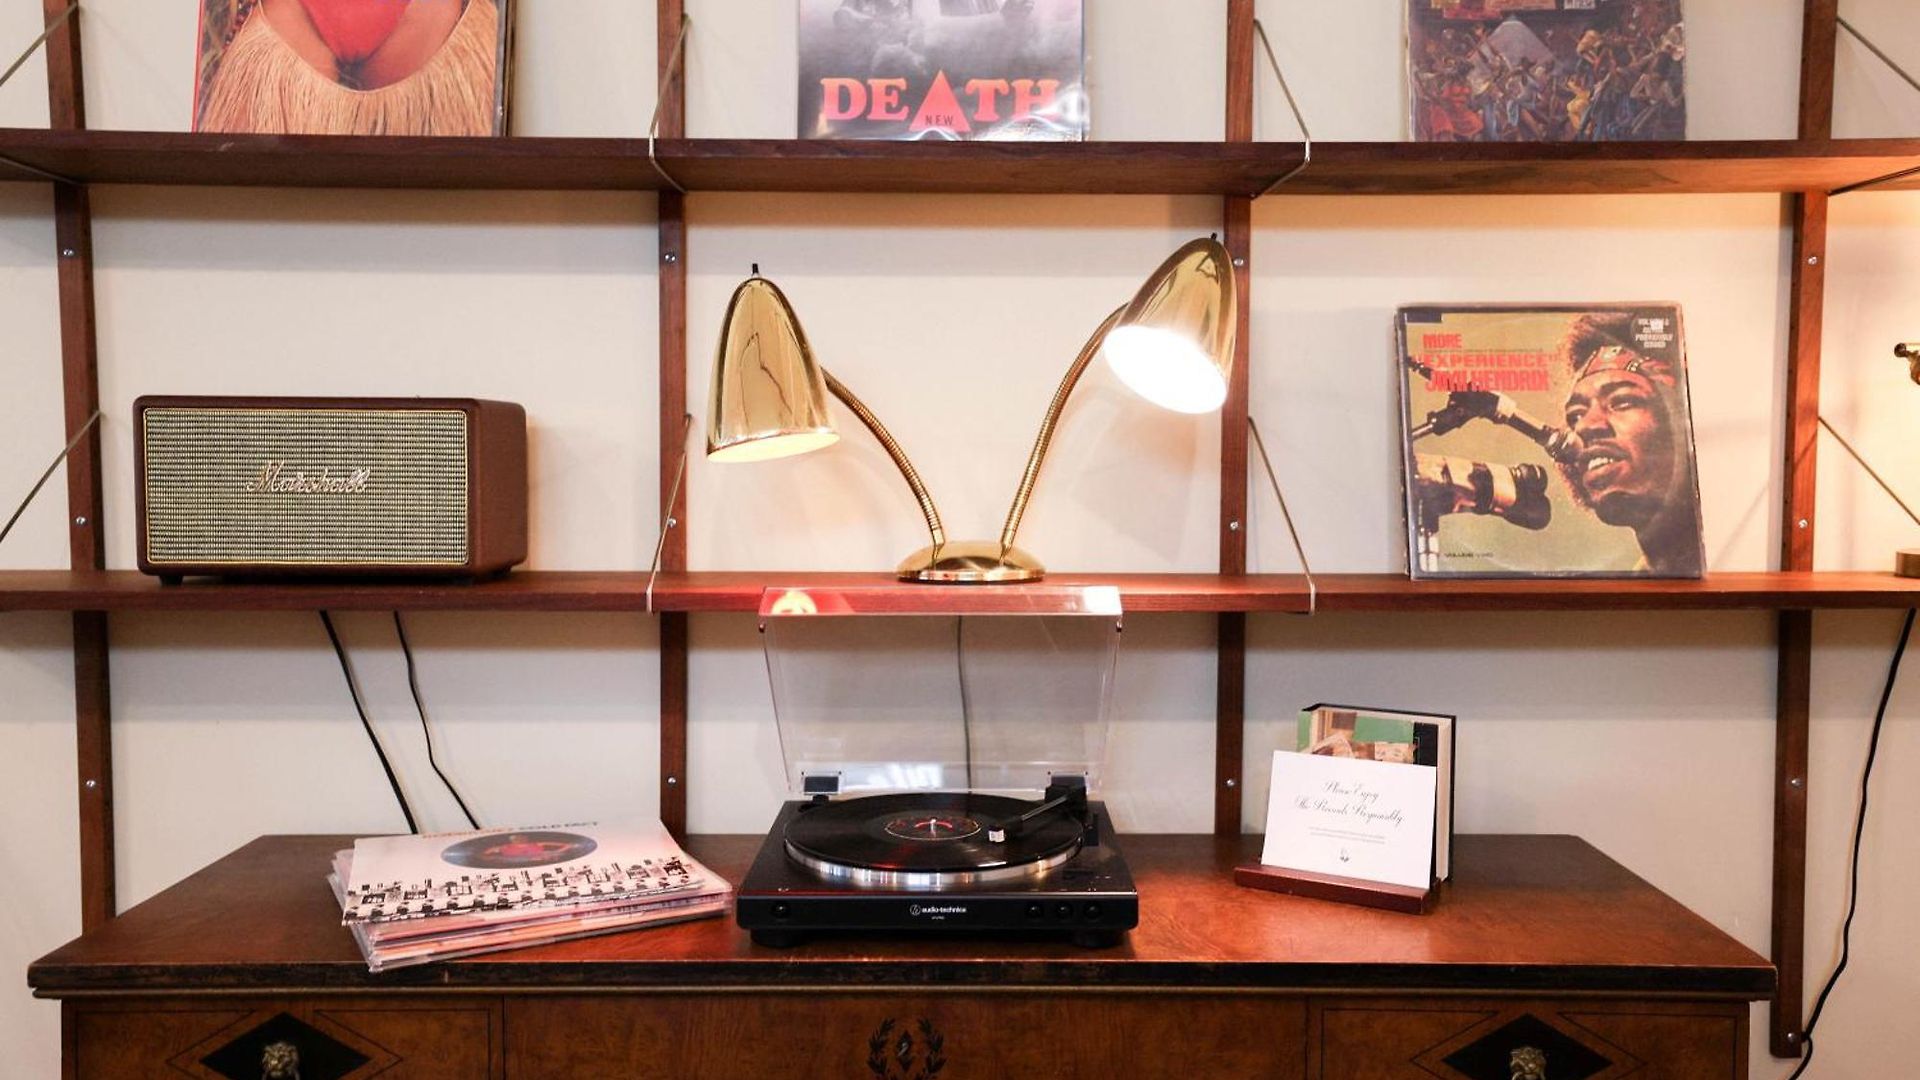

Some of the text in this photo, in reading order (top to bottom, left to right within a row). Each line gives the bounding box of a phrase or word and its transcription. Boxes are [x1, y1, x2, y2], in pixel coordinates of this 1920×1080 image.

[820, 69, 1060, 132] DEATH
[1423, 334, 1462, 349] MORE
[246, 459, 370, 493] Marshall
